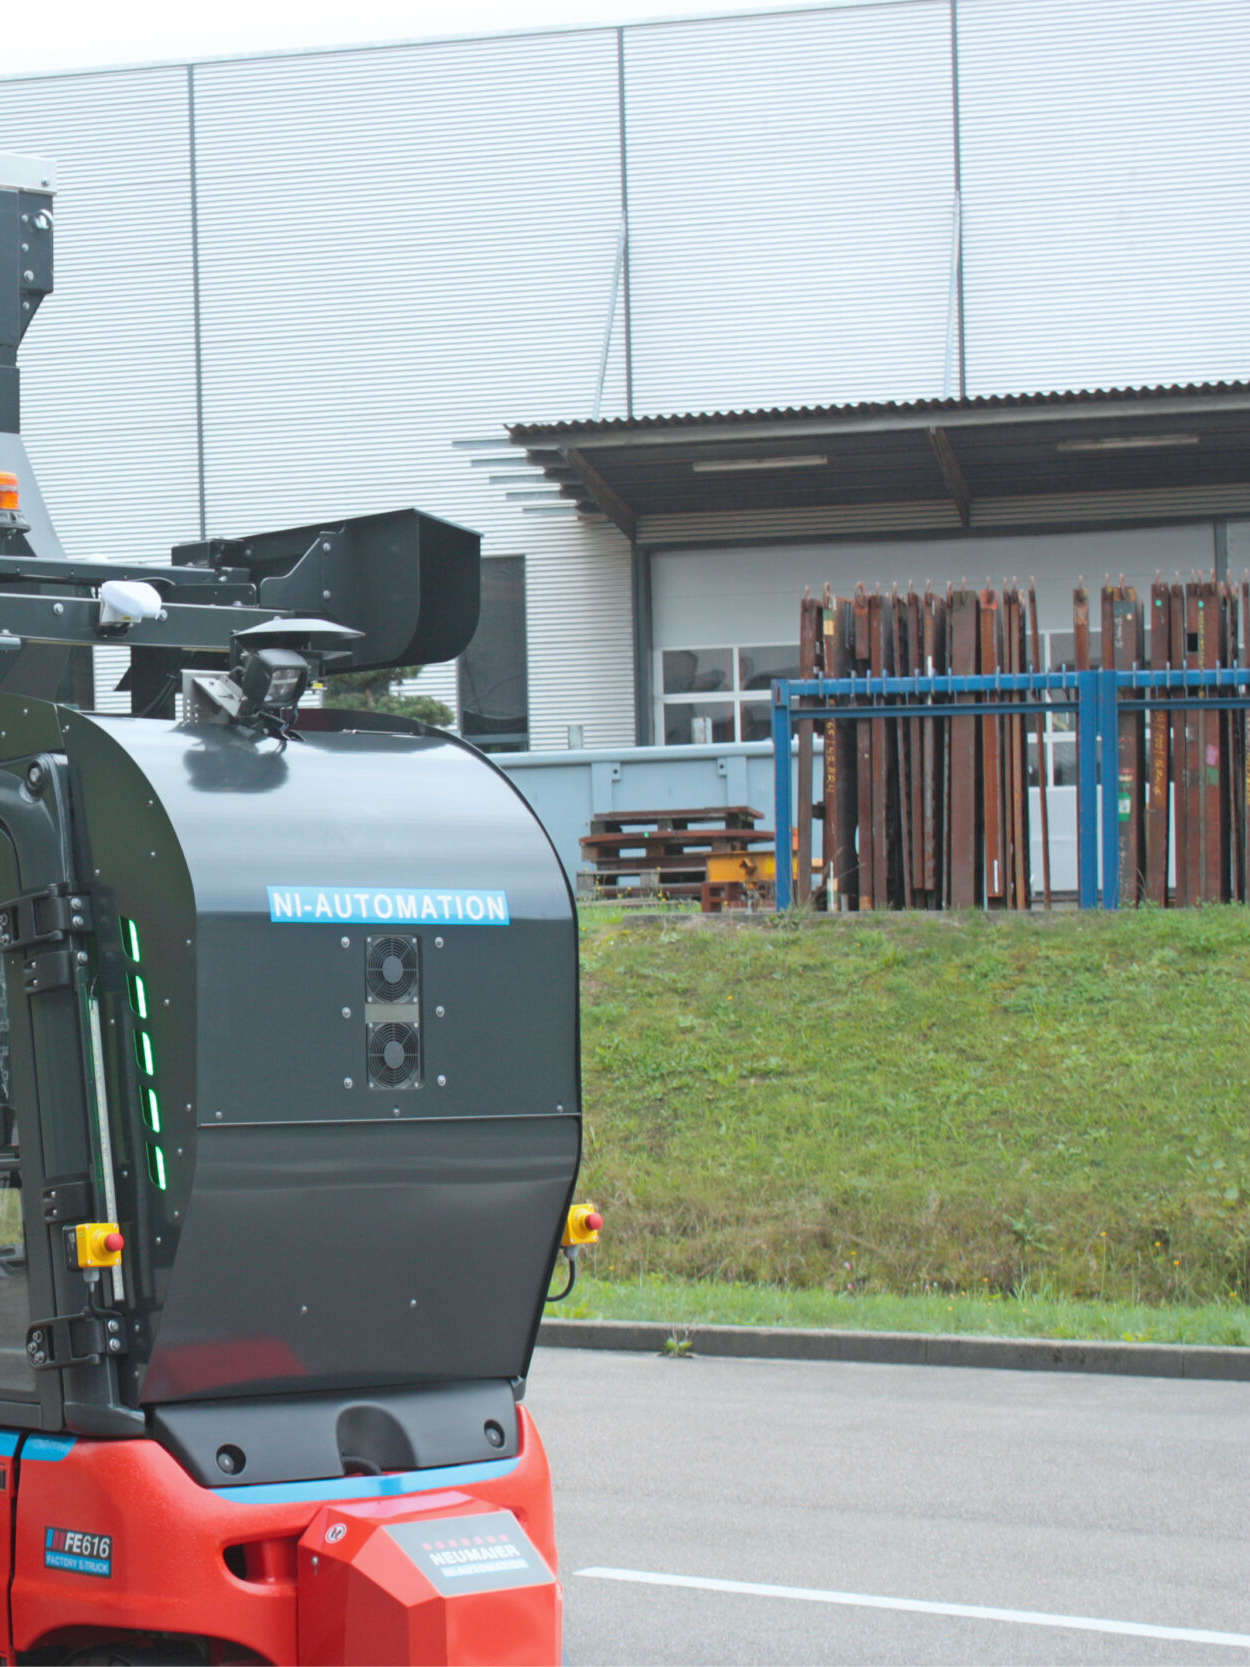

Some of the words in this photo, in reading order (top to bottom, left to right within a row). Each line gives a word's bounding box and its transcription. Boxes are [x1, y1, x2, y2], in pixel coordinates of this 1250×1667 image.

[272, 892, 507, 921] NI-AUTOMATION
[64, 1531, 111, 1558] FE616
[429, 1544, 521, 1567] NEUMAIER
[46, 1553, 77, 1568] FACTORY
